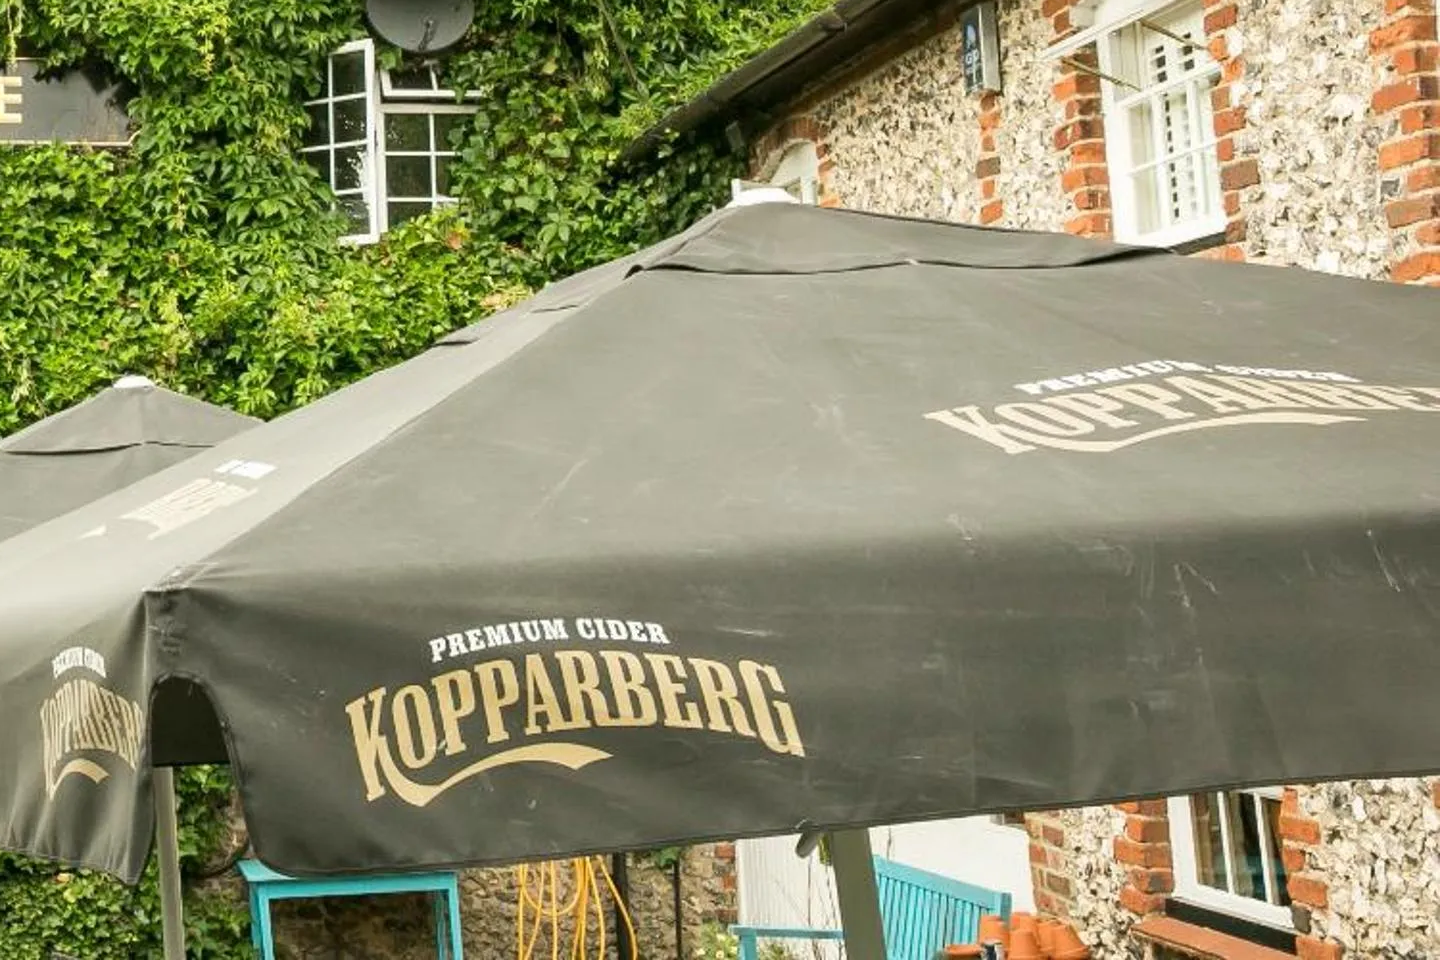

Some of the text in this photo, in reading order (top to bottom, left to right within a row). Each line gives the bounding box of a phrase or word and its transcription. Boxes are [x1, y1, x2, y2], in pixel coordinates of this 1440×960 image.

[922, 374, 1440, 455] KOPPARBE
[429, 617, 671, 663] PREMIUM CIDER
[344, 650, 806, 807] KOPPARBERG
